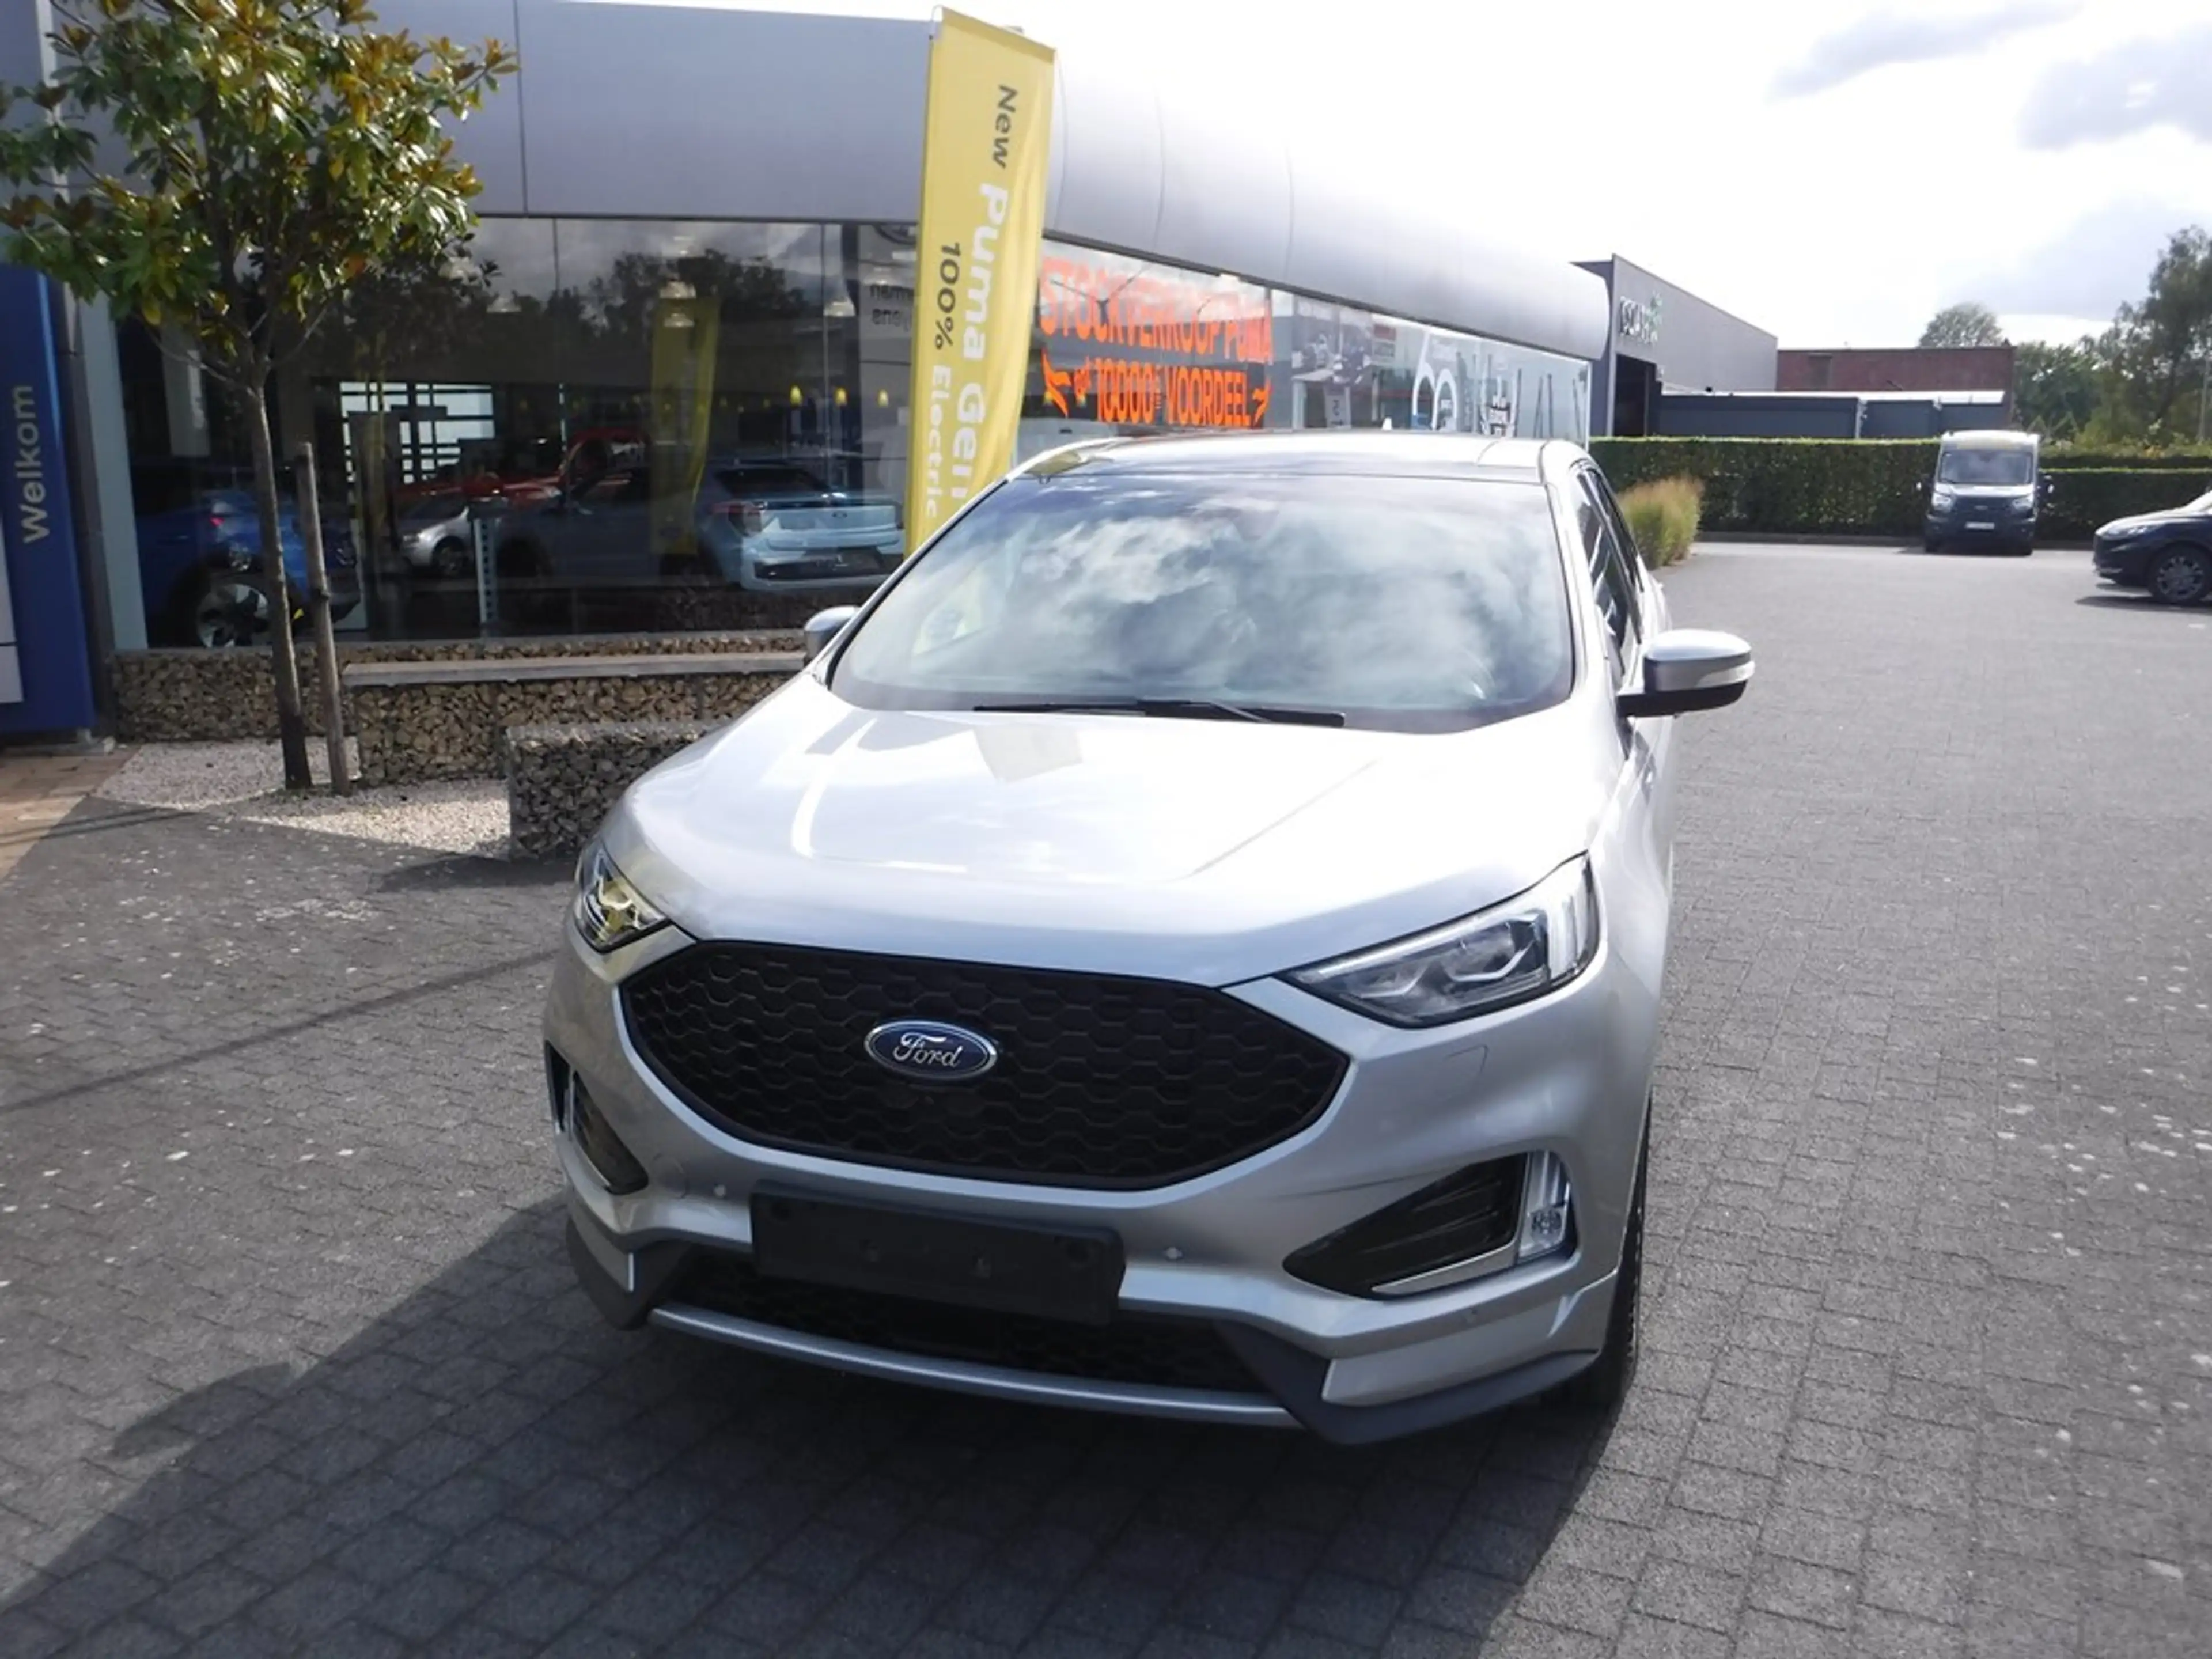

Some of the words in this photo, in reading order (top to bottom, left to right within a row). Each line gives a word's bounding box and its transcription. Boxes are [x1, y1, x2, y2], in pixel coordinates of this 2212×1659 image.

[991, 84, 1018, 169] New
[934, 242, 960, 350] 100%
[963, 182, 1009, 361] Puma
[926, 365, 952, 519] Electric
[1165, 363, 1252, 427] VOORDEEL
[13, 385, 50, 544] Welkom
[893, 1032, 963, 1067] Ford
